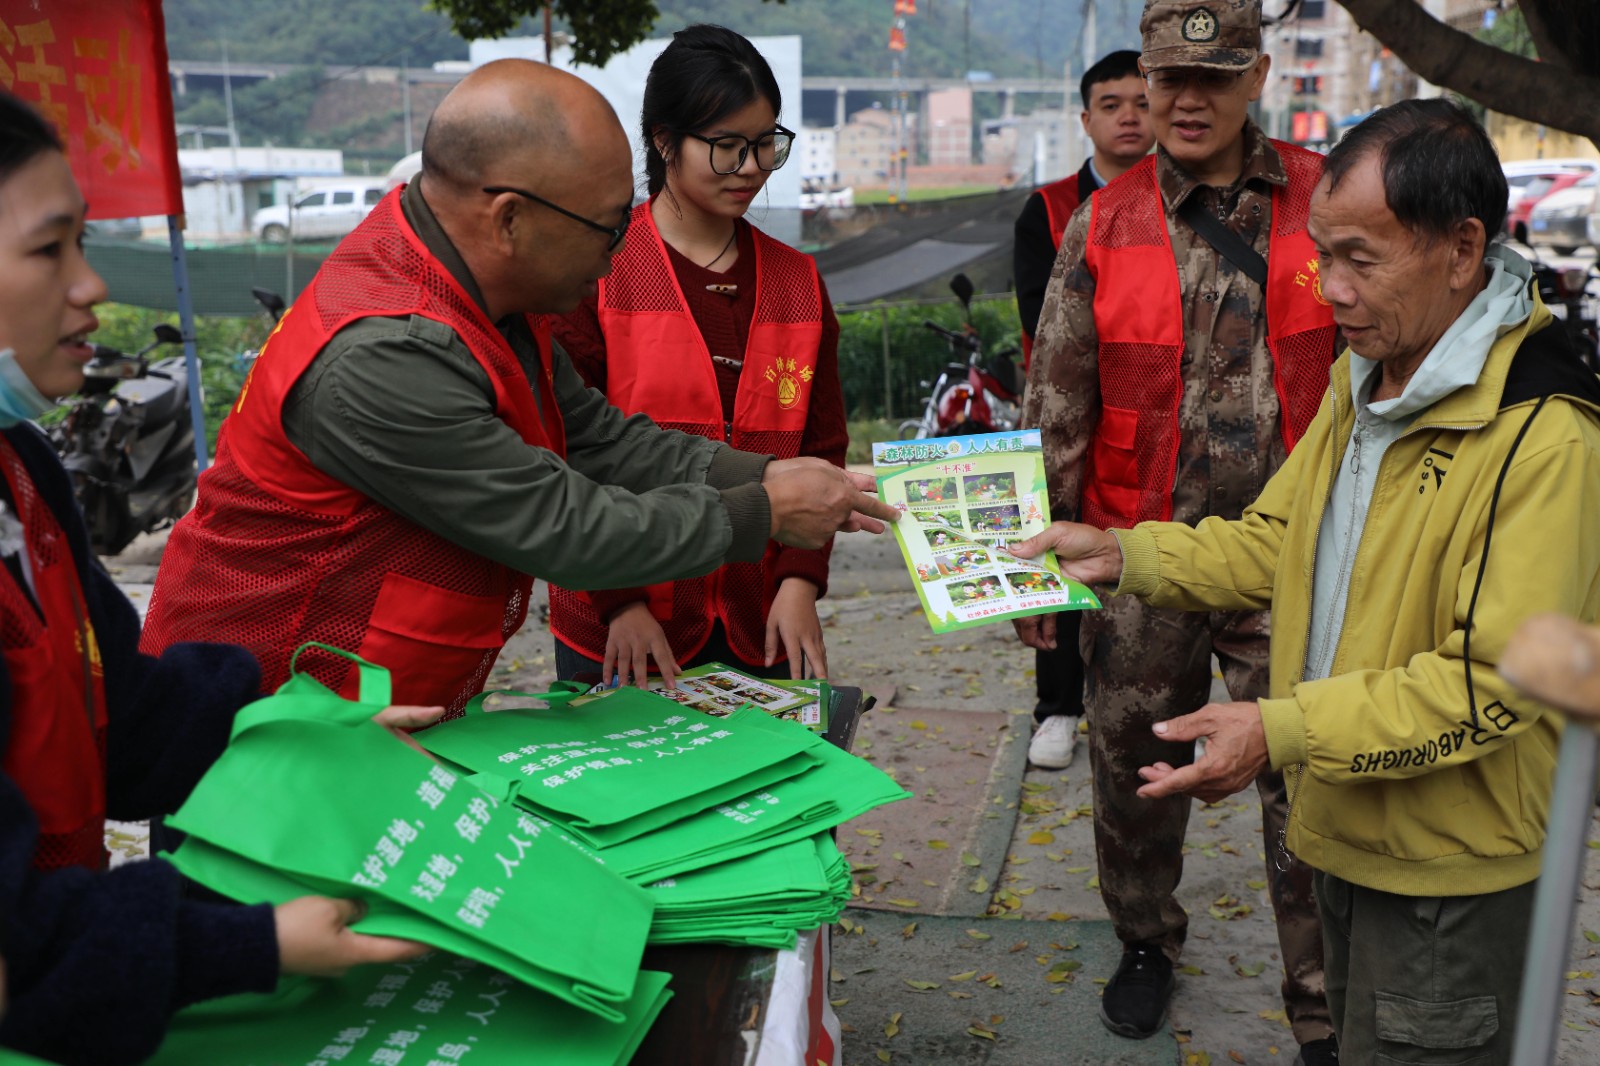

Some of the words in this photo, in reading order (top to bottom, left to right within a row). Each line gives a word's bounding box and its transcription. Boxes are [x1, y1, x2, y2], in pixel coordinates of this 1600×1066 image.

[885, 444, 945, 461] 森林防火
[966, 437, 1024, 454] 人人有责
